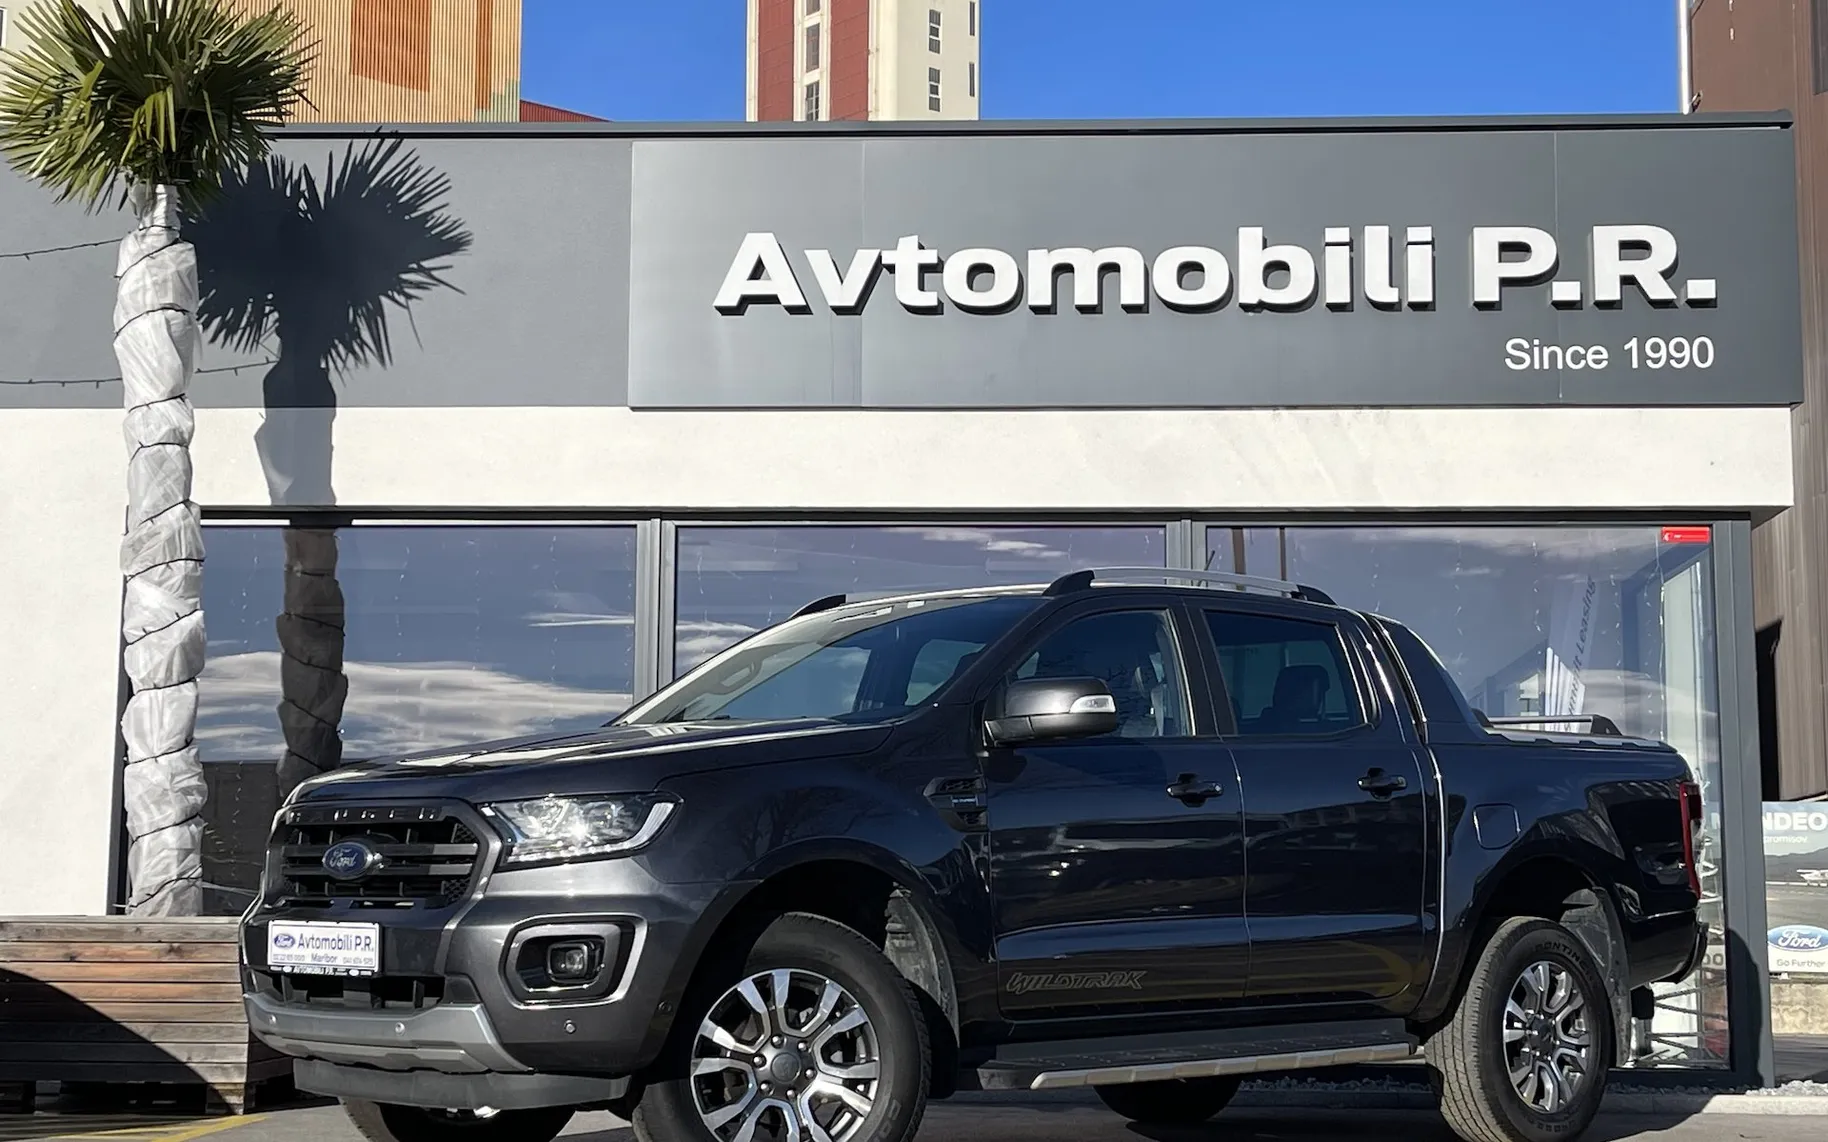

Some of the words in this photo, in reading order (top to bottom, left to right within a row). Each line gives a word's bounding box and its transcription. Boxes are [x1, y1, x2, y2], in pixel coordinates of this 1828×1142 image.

[713, 225, 1434, 312] Avtomobili
[1472, 224, 1717, 308] P.R.
[1504, 337, 1609, 371] Since
[1623, 336, 1714, 370] 1990
[1576, 576, 1597, 653] Leasing
[329, 848, 358, 870] Ford
[297, 933, 353, 950] Avtomobili
[354, 935, 375, 952] P.R.
[1778, 929, 1822, 947] Ford
[1791, 959, 1825, 967] Further
[1006, 971, 1148, 994] WILDTRAK
